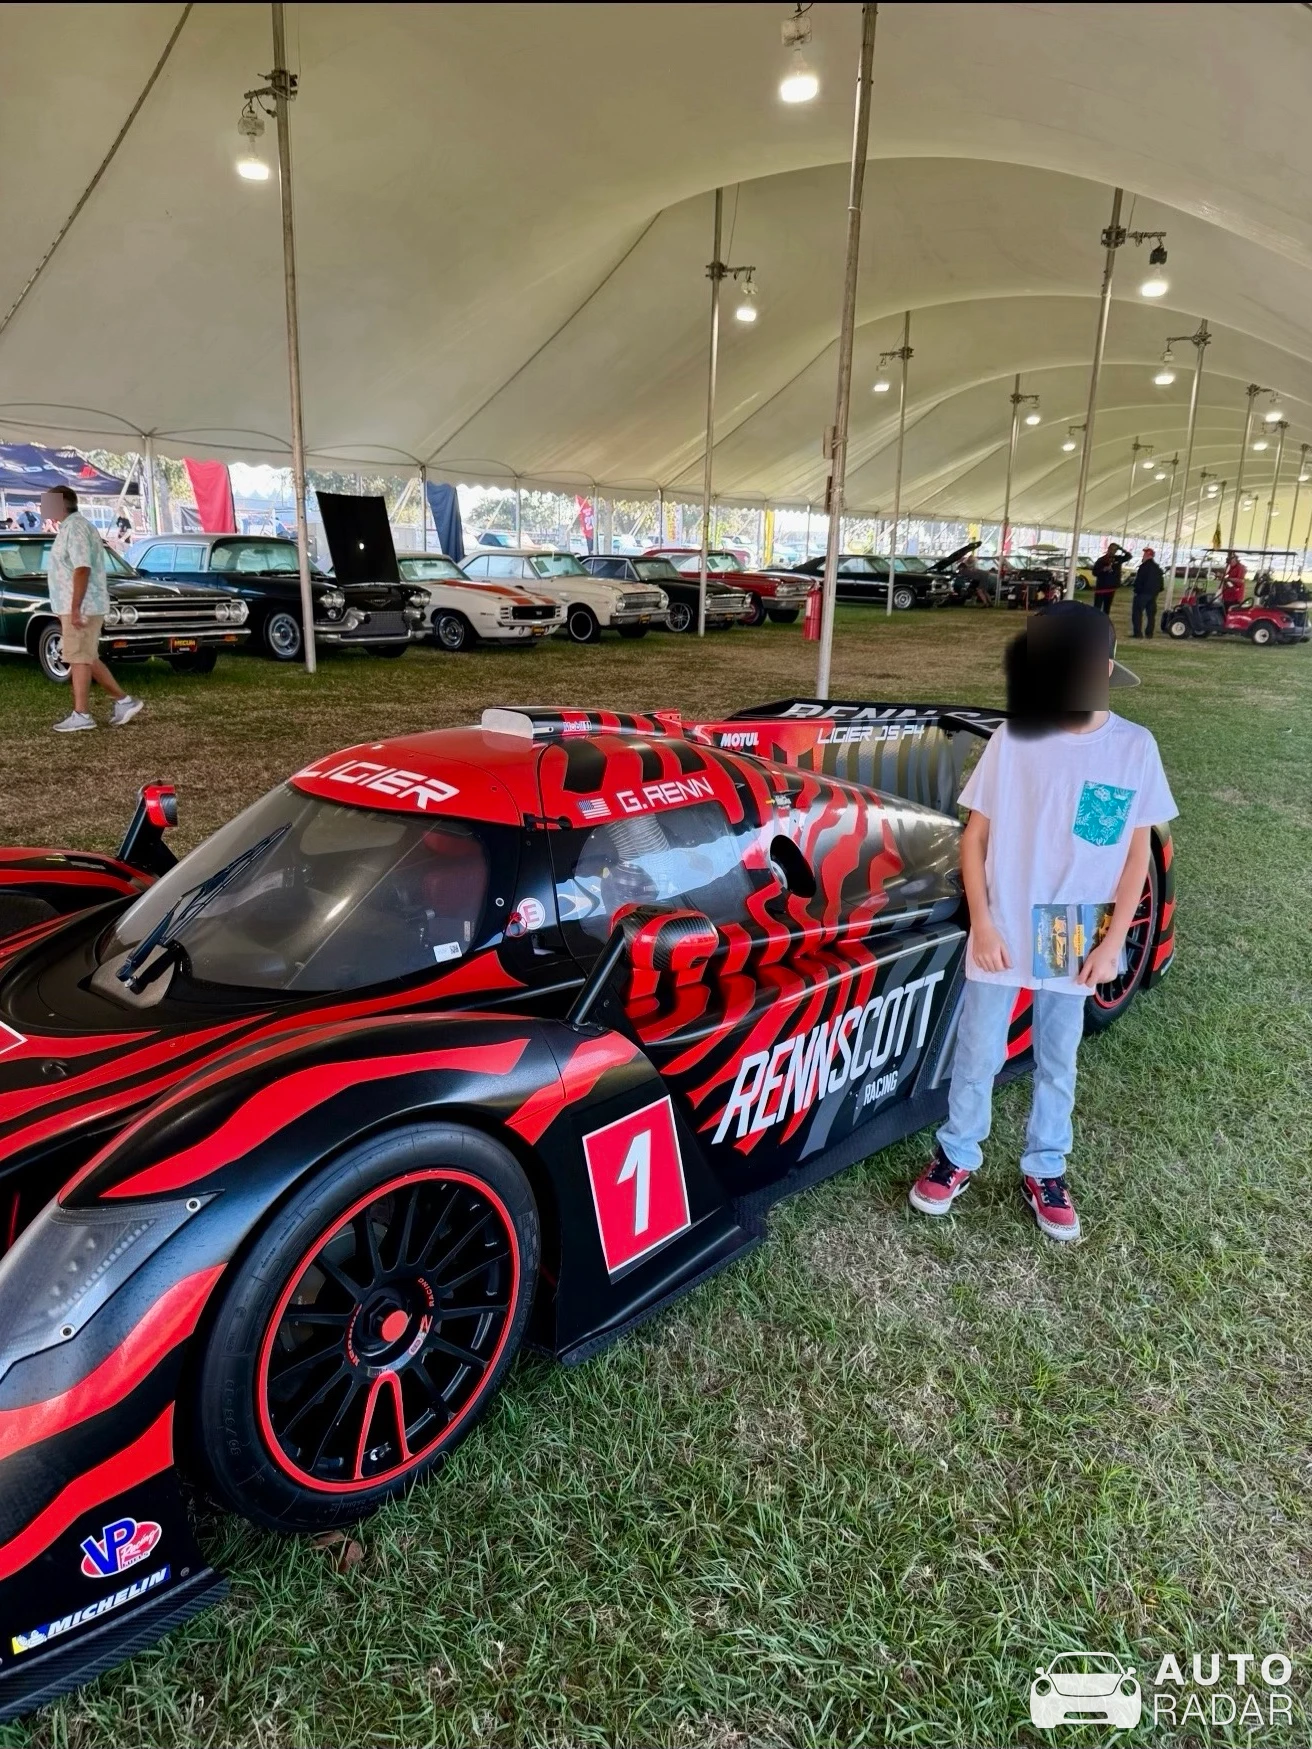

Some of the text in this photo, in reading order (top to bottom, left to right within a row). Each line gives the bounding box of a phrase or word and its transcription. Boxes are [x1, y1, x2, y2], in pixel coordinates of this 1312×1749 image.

[720, 732, 759, 747] MOTUL
[817, 724, 924, 744] LIGIER JS P4
[291, 757, 460, 810] LIGIER
[523, 904, 539, 923] E
[711, 970, 944, 1144] RENNSCOTT
[863, 1070, 898, 1107] RACING
[617, 1129, 651, 1236] 1
[418, 1277, 435, 1307] RACING
[80, 1517, 137, 1577] VP
[121, 1528, 159, 1560] Racing
[47, 1567, 167, 1639] MICHELIN
